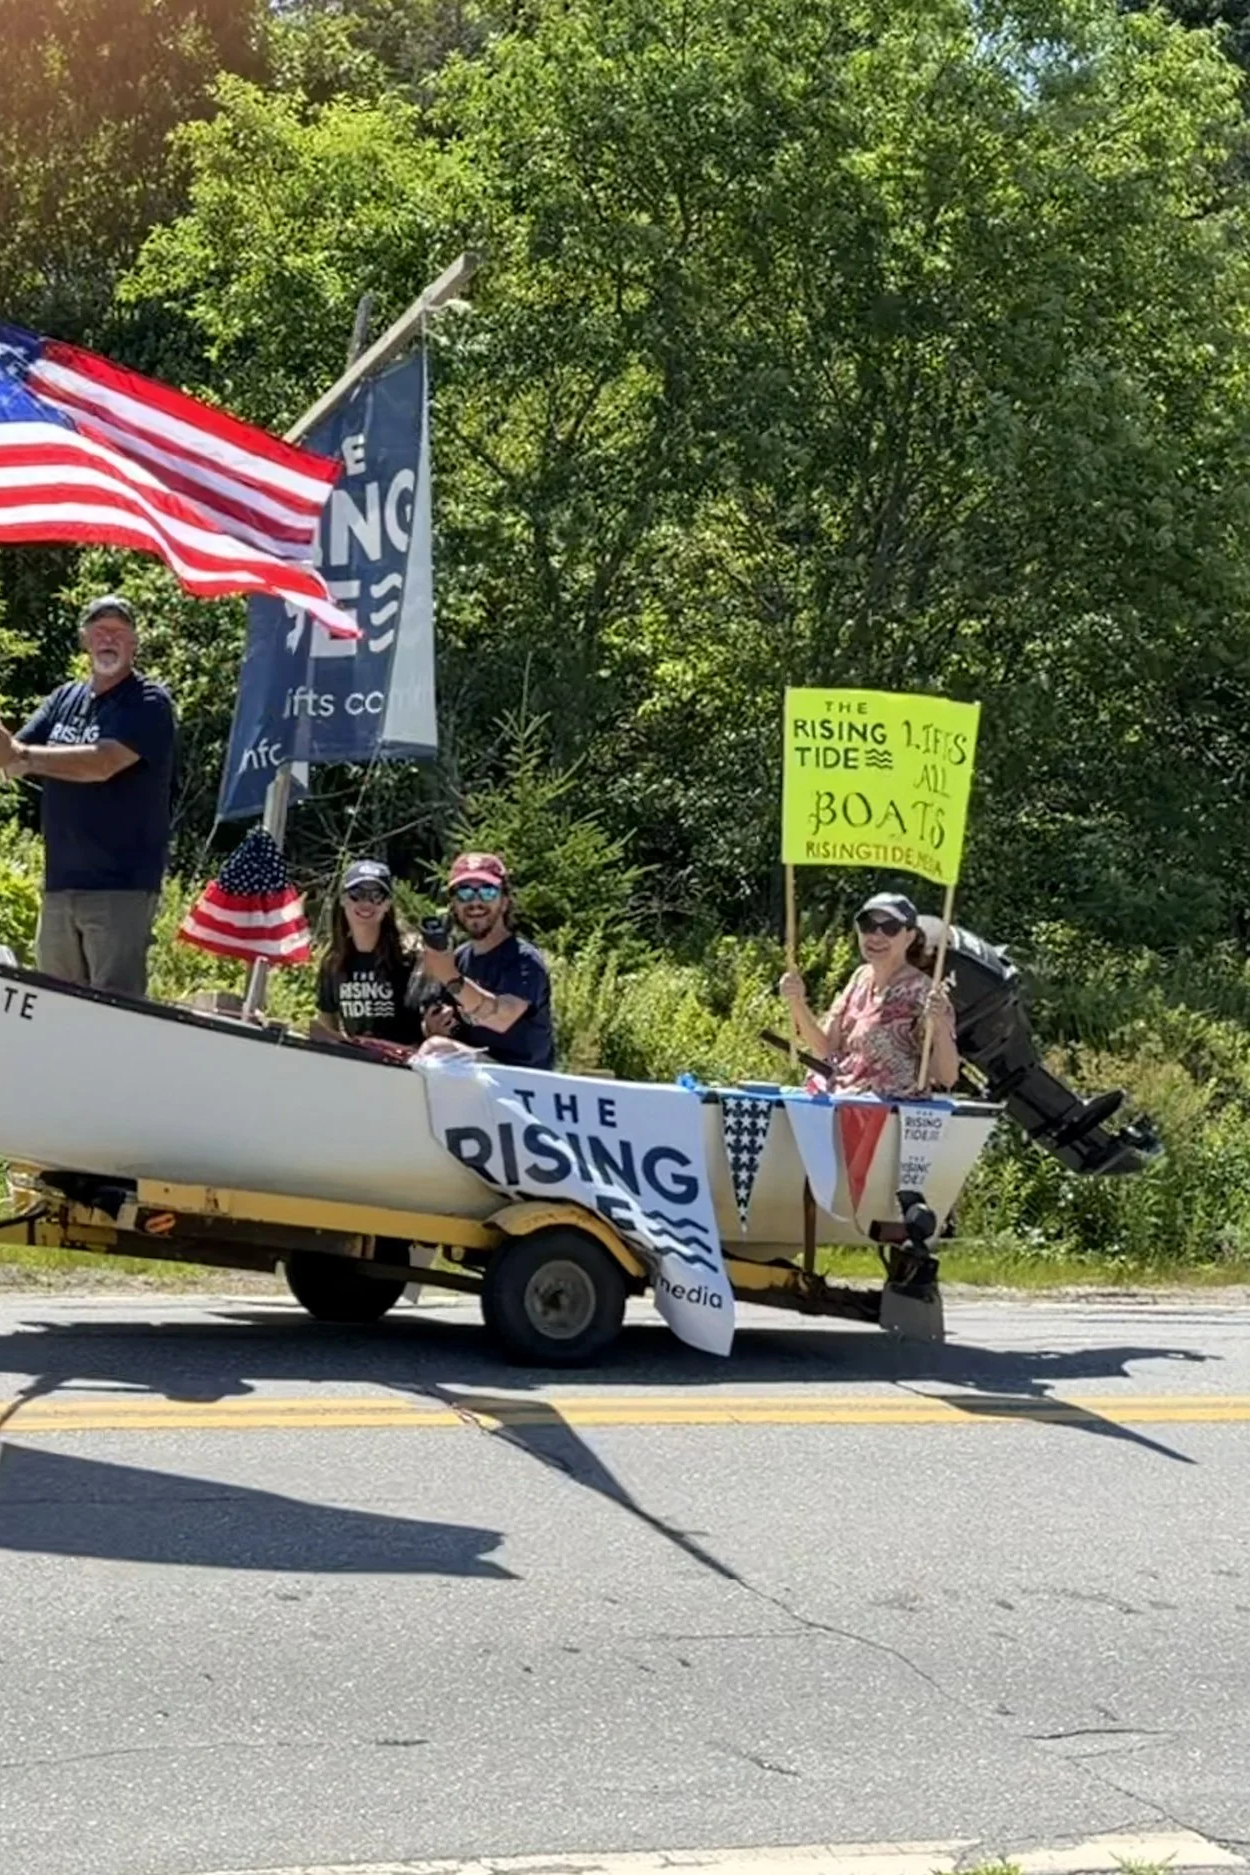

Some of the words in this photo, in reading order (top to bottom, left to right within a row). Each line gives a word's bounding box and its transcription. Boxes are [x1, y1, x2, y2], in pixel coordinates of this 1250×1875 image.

[825, 700, 869, 715] THE
[793, 718, 887, 745] RISING
[795, 746, 859, 770] TIDE
[809, 790, 946, 850] BOATS
[339, 981, 394, 1000] RISING
[340, 1000, 373, 1018] TIDE
[514, 1089, 618, 1128] THE
[445, 1121, 700, 1206] RISING
